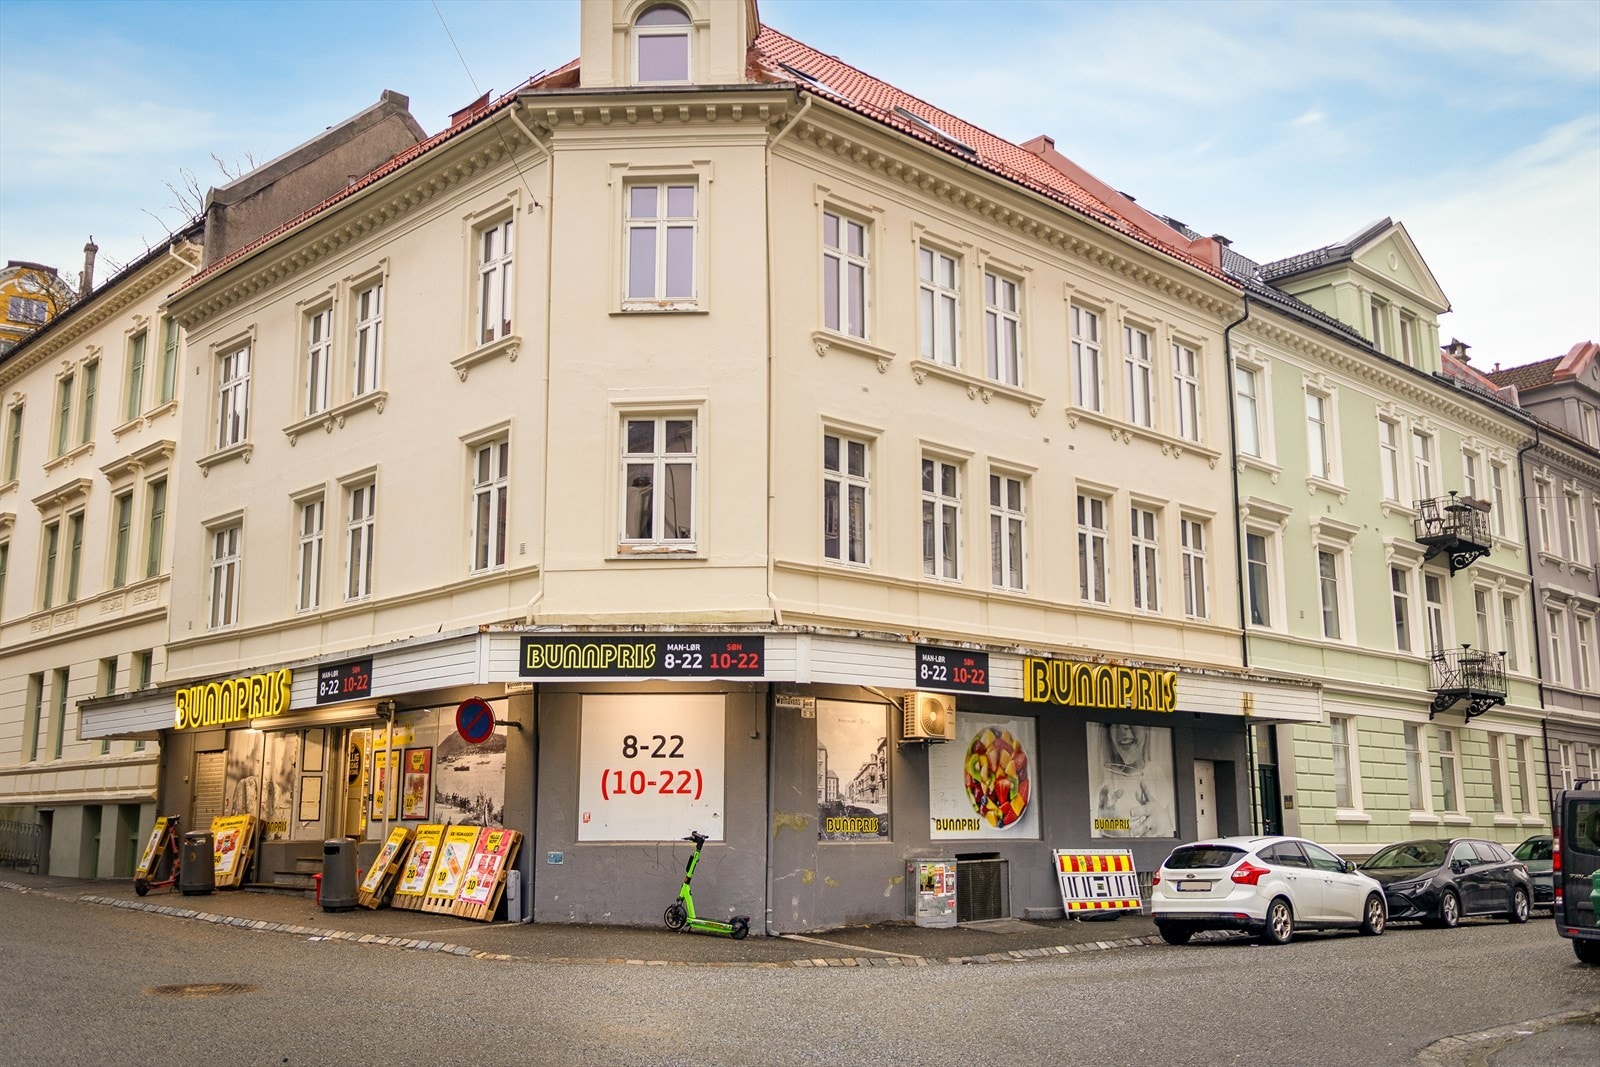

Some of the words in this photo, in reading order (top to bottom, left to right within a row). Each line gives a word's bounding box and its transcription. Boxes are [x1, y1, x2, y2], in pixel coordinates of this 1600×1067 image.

[667, 643, 701, 651] MAN-LØR
[726, 643, 742, 651] SØN
[526, 644, 656, 669] BUNNPRIS
[664, 653, 703, 669] 8-22
[710, 653, 759, 669] 10-22
[922, 653, 946, 664] MAN-LØR
[963, 657, 975, 667] SØN
[920, 664, 947, 682] 8-22
[953, 666, 986, 685] 10-22
[320, 679, 339, 697] 8-22
[343, 674, 369, 693] 10-22
[1024, 656, 1177, 712] BUNNPRIS
[174, 668, 293, 730] BUNNPRIS
[622, 735, 685, 759] 8-22
[601, 768, 704, 800] (10-22)
[826, 817, 879, 834] BUNNPRIS
[935, 818, 980, 831] BUNNPRIS
[1094, 818, 1130, 830] BUNNPRIS
[407, 869, 416, 879] 20
[438, 871, 447, 882] 10
[467, 880, 477, 890] 10
